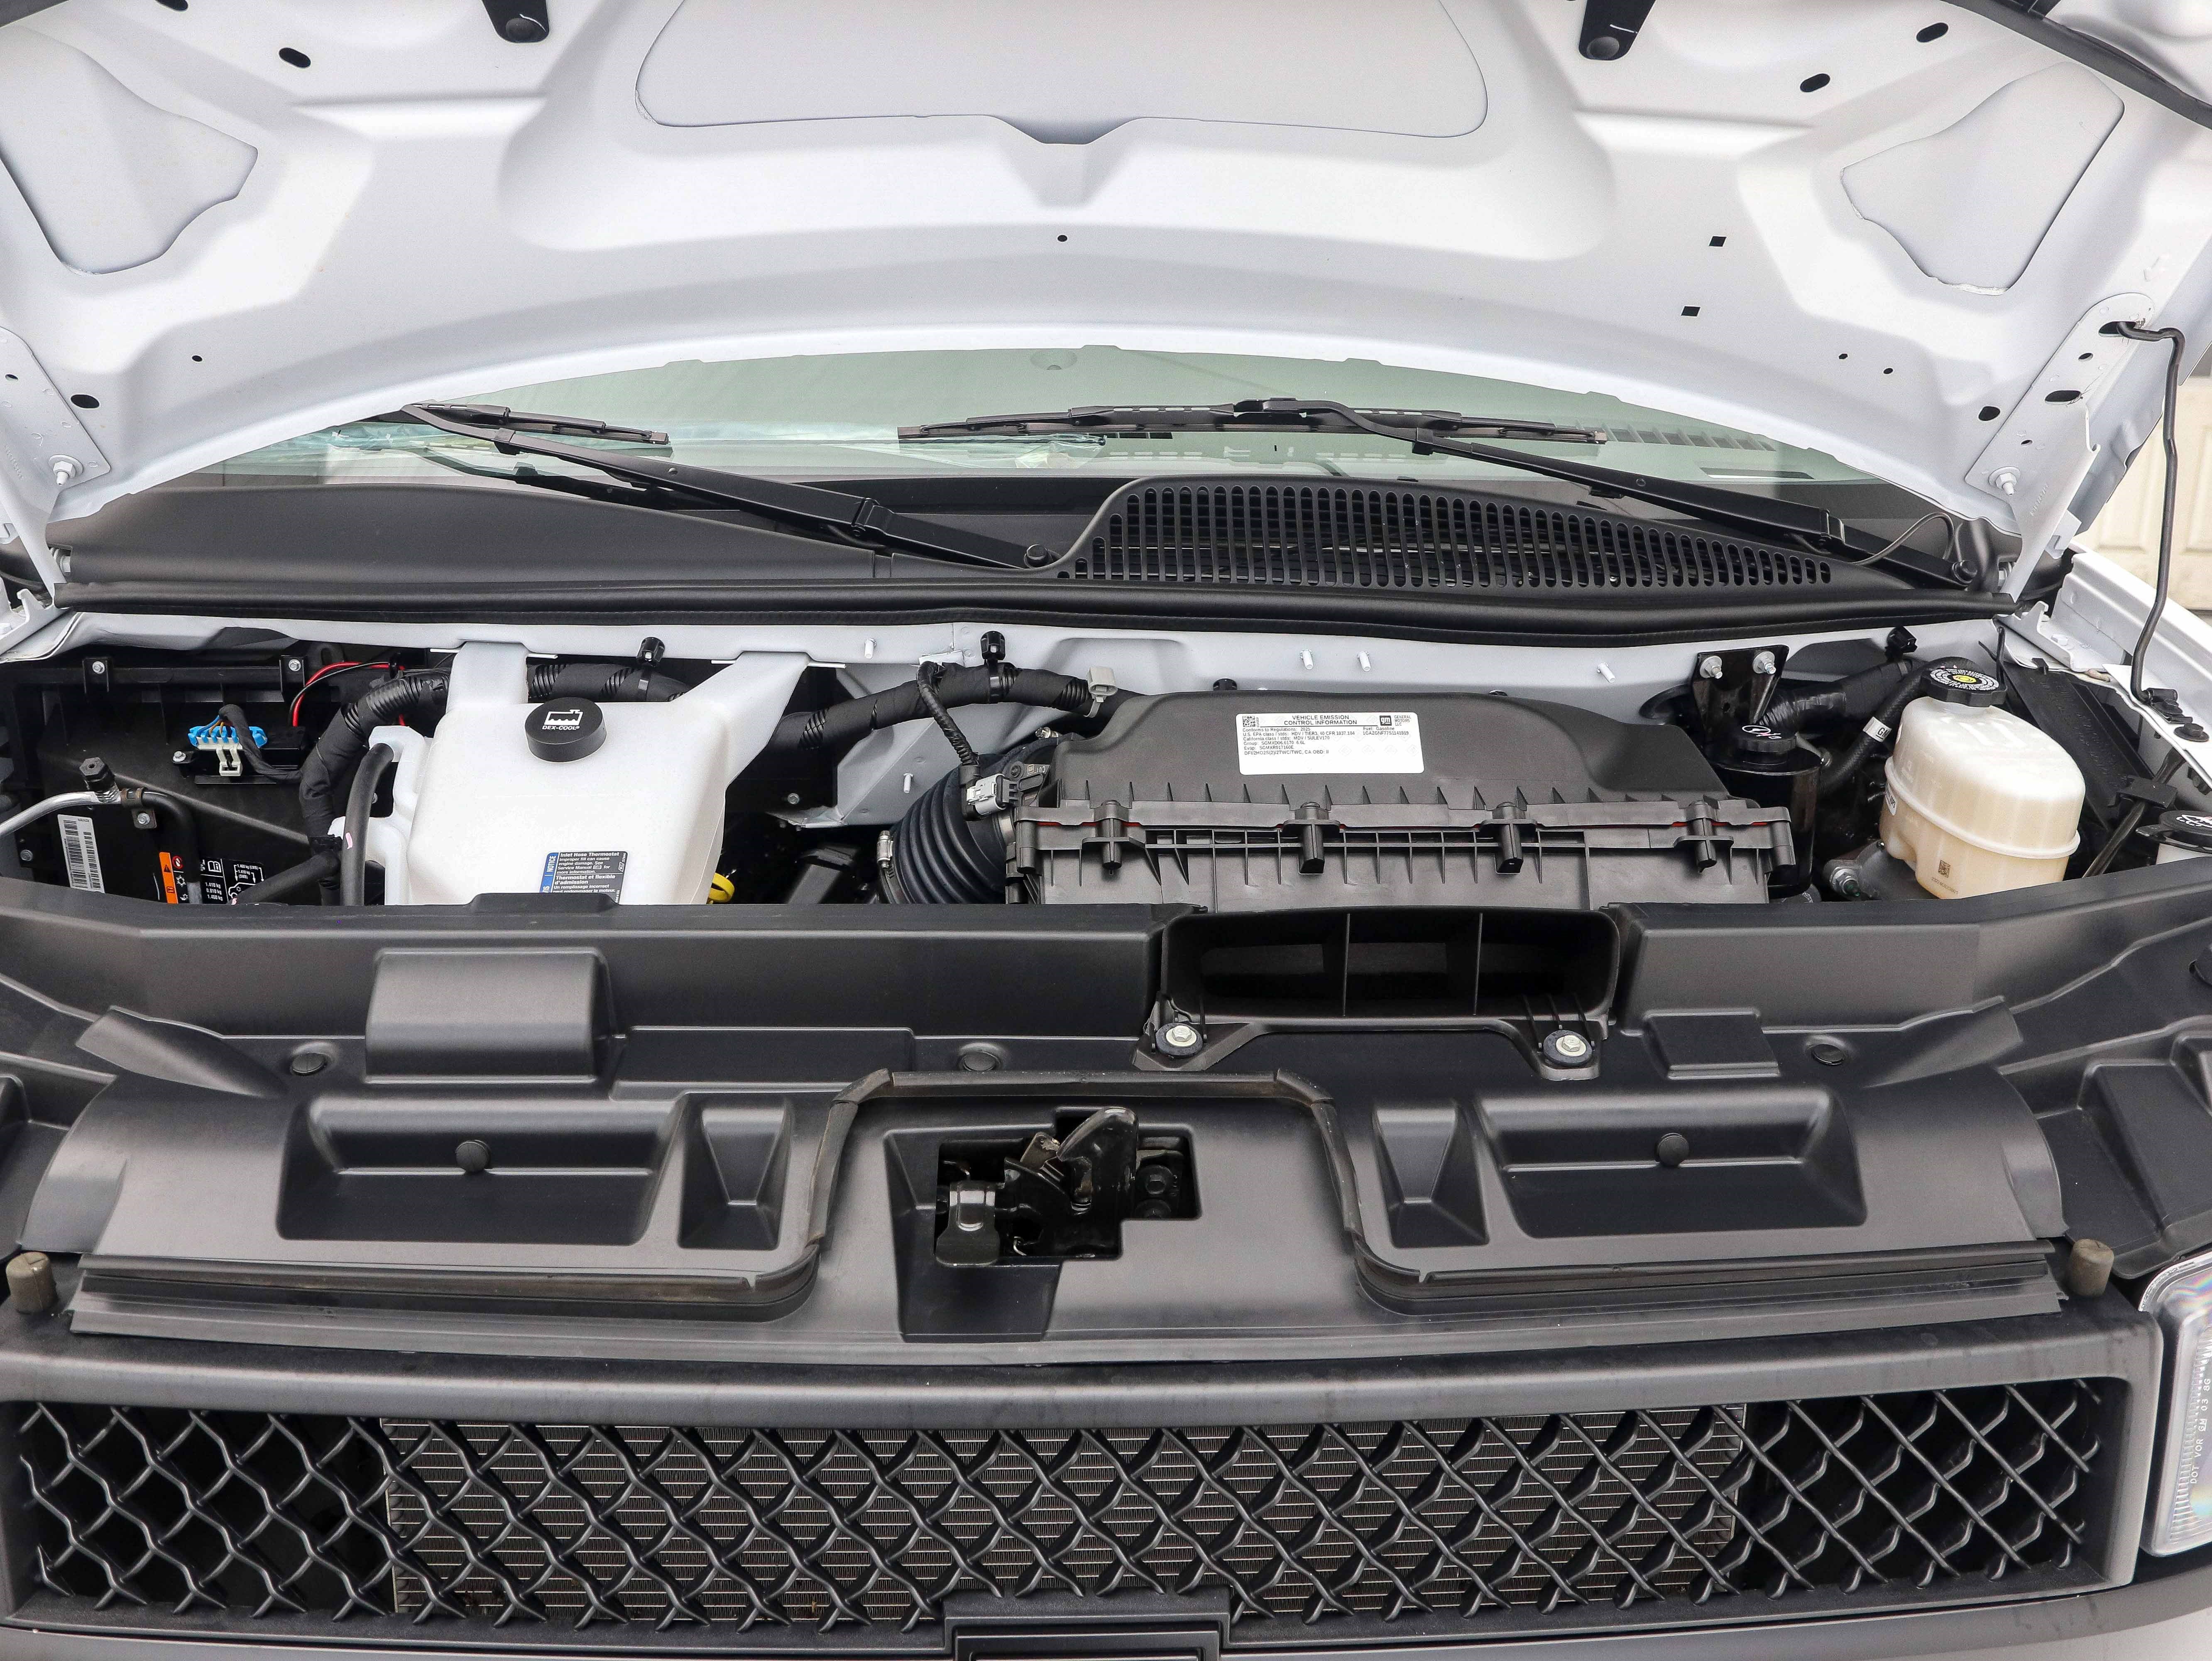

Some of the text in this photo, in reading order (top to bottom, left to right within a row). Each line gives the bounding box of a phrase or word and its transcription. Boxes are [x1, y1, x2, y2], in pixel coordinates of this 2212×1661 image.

[546, 855, 556, 872] NOTICE
[2190, 1465, 2199, 1484] DOT
[2195, 1439, 2204, 1458] VOR
[2201, 1399, 2209, 1411] 03
